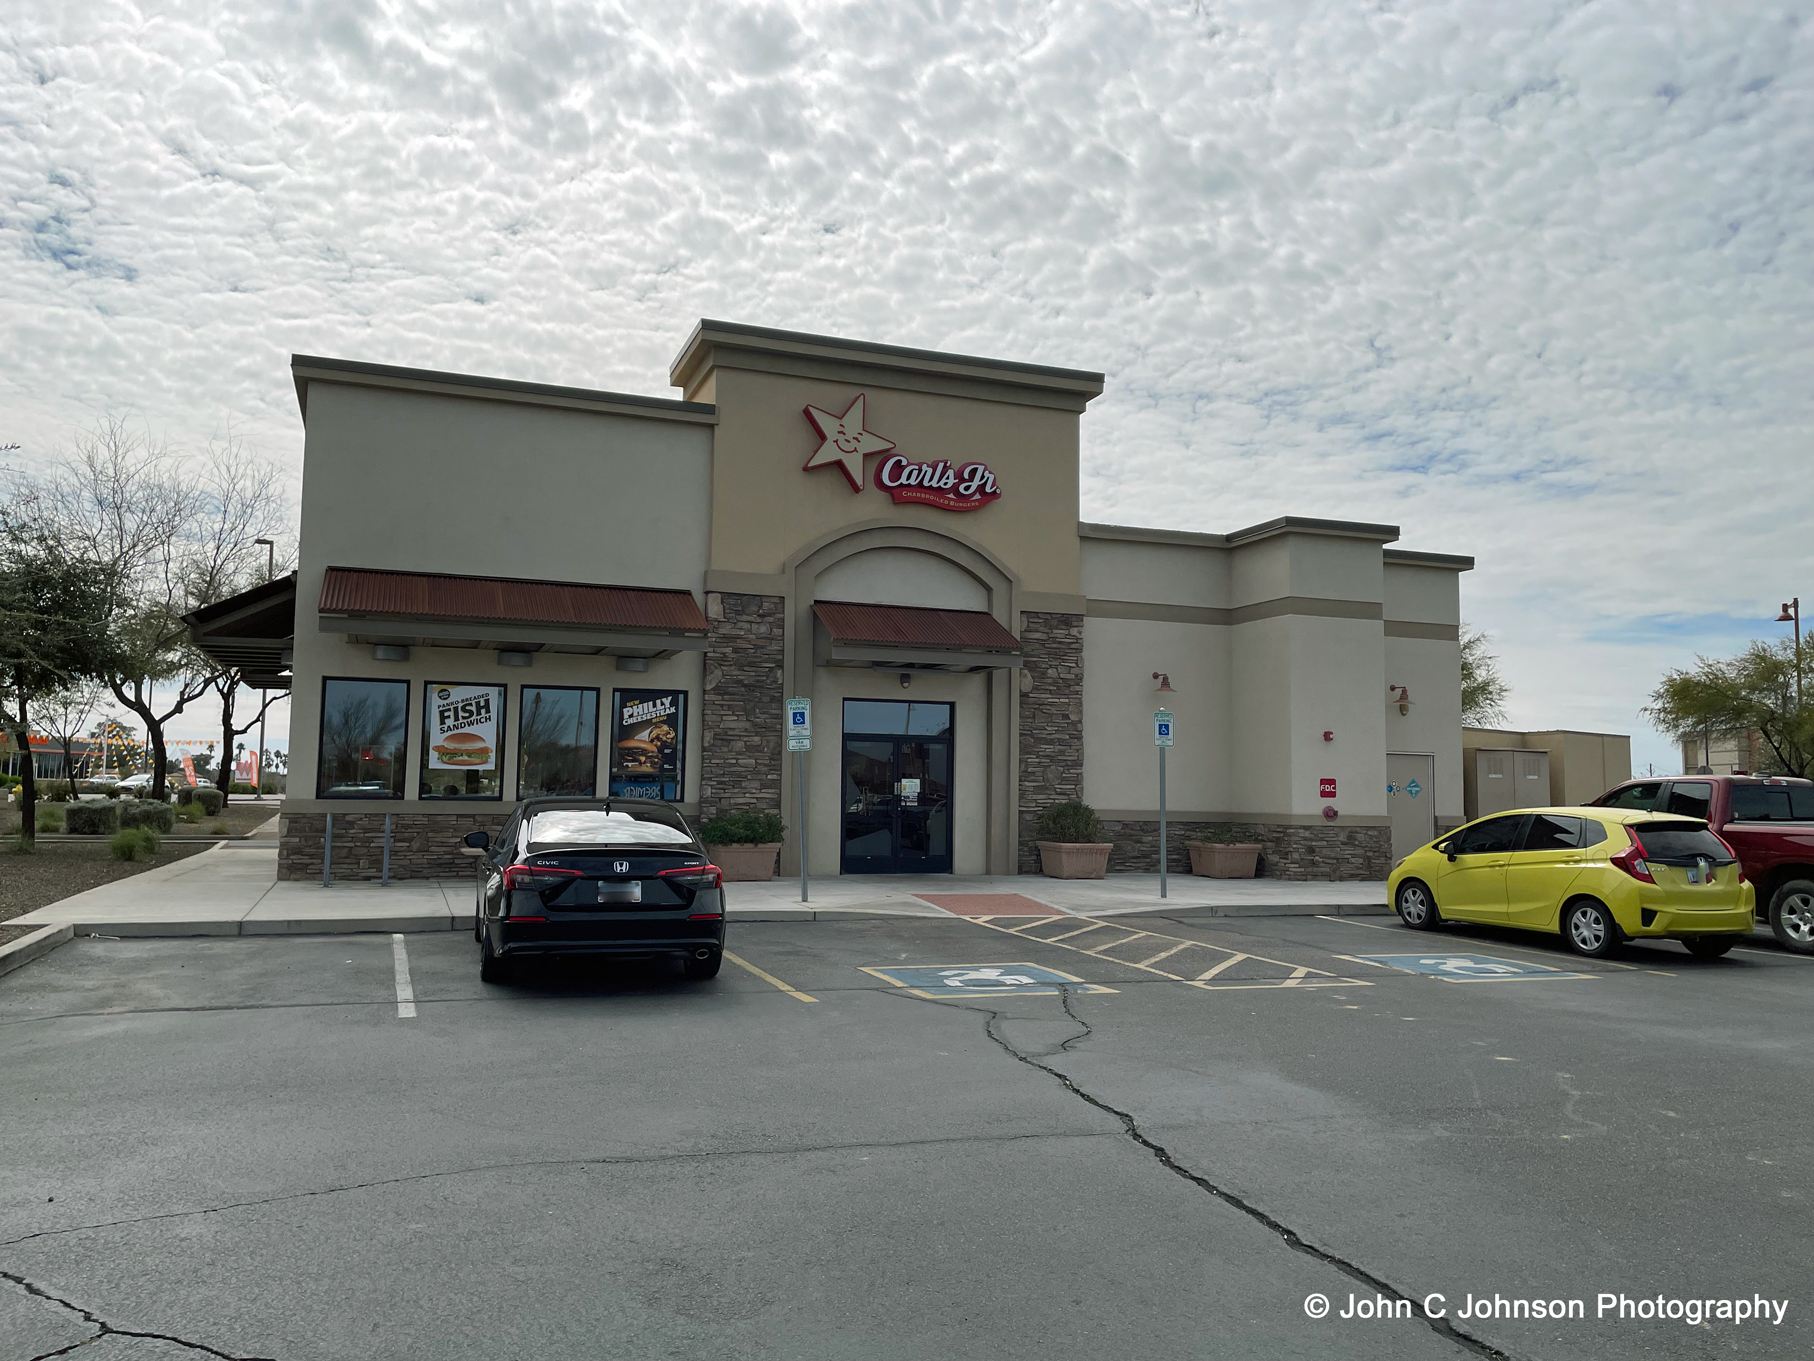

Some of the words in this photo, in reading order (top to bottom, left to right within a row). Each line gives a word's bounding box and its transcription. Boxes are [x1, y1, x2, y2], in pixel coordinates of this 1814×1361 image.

[881, 456, 958, 489] Carl's
[902, 491, 948, 505] CHARBROILED
[437, 692, 490, 710] PANKO-BREADED
[623, 696, 673, 719] PHILLY
[626, 699, 640, 707] NEW
[439, 698, 491, 726] FISH
[622, 706, 676, 726] CHEESESTEAK
[439, 714, 492, 735] SANDWICH
